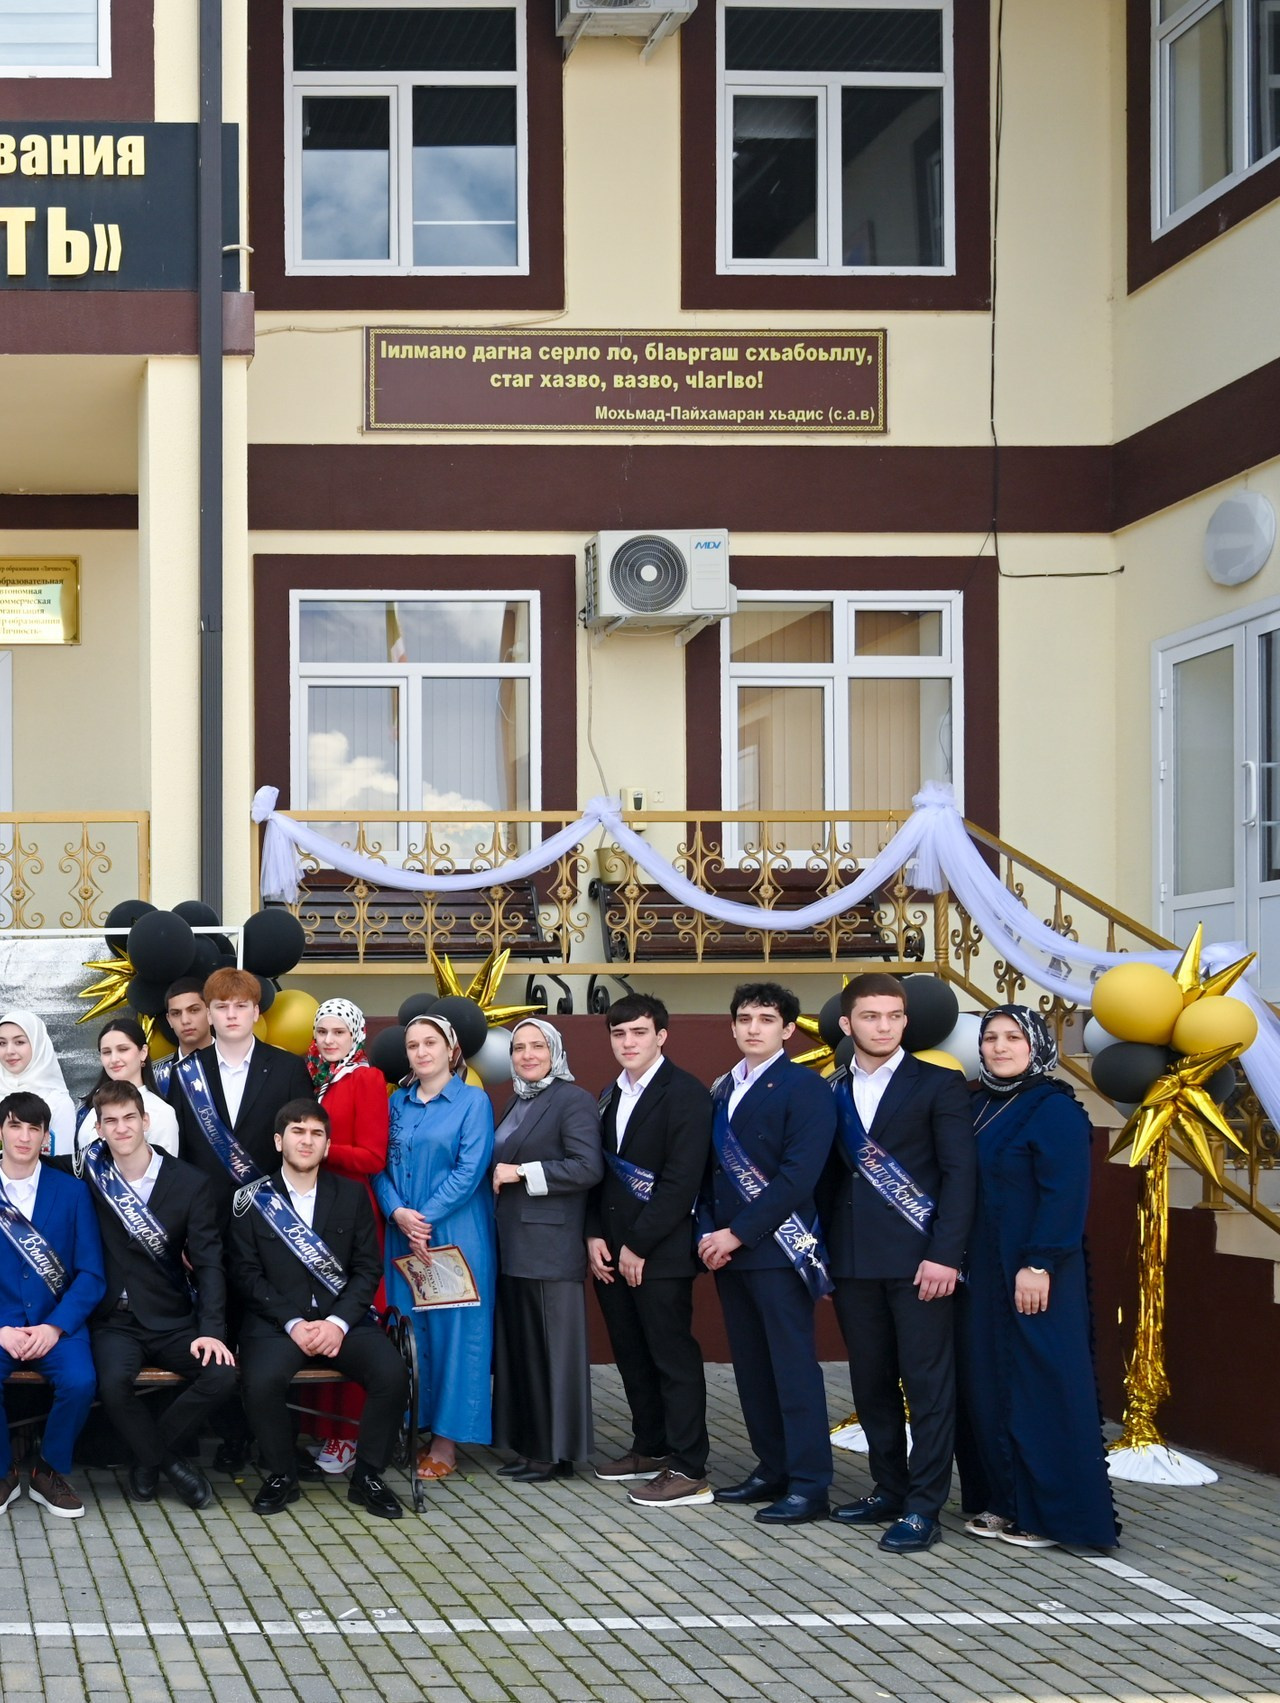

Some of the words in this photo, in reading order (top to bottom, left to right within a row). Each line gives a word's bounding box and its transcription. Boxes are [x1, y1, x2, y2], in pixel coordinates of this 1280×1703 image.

[472, 344, 533, 363] дагна
[538, 344, 601, 365] серло
[606, 345, 639, 363] ло,
[745, 342, 873, 366] схьабоьллу,
[489, 373, 534, 388] стаг
[539, 373, 607, 393] хазво,
[613, 374, 679, 393] вазво,
[595, 405, 765, 423] Мохьмад-Пайхамаран
[768, 409, 824, 423] хьадис
[828, 406, 875, 424] (с.а.в)
[694, 541, 722, 550] MDV
[857, 1141, 931, 1223] Выпускник
